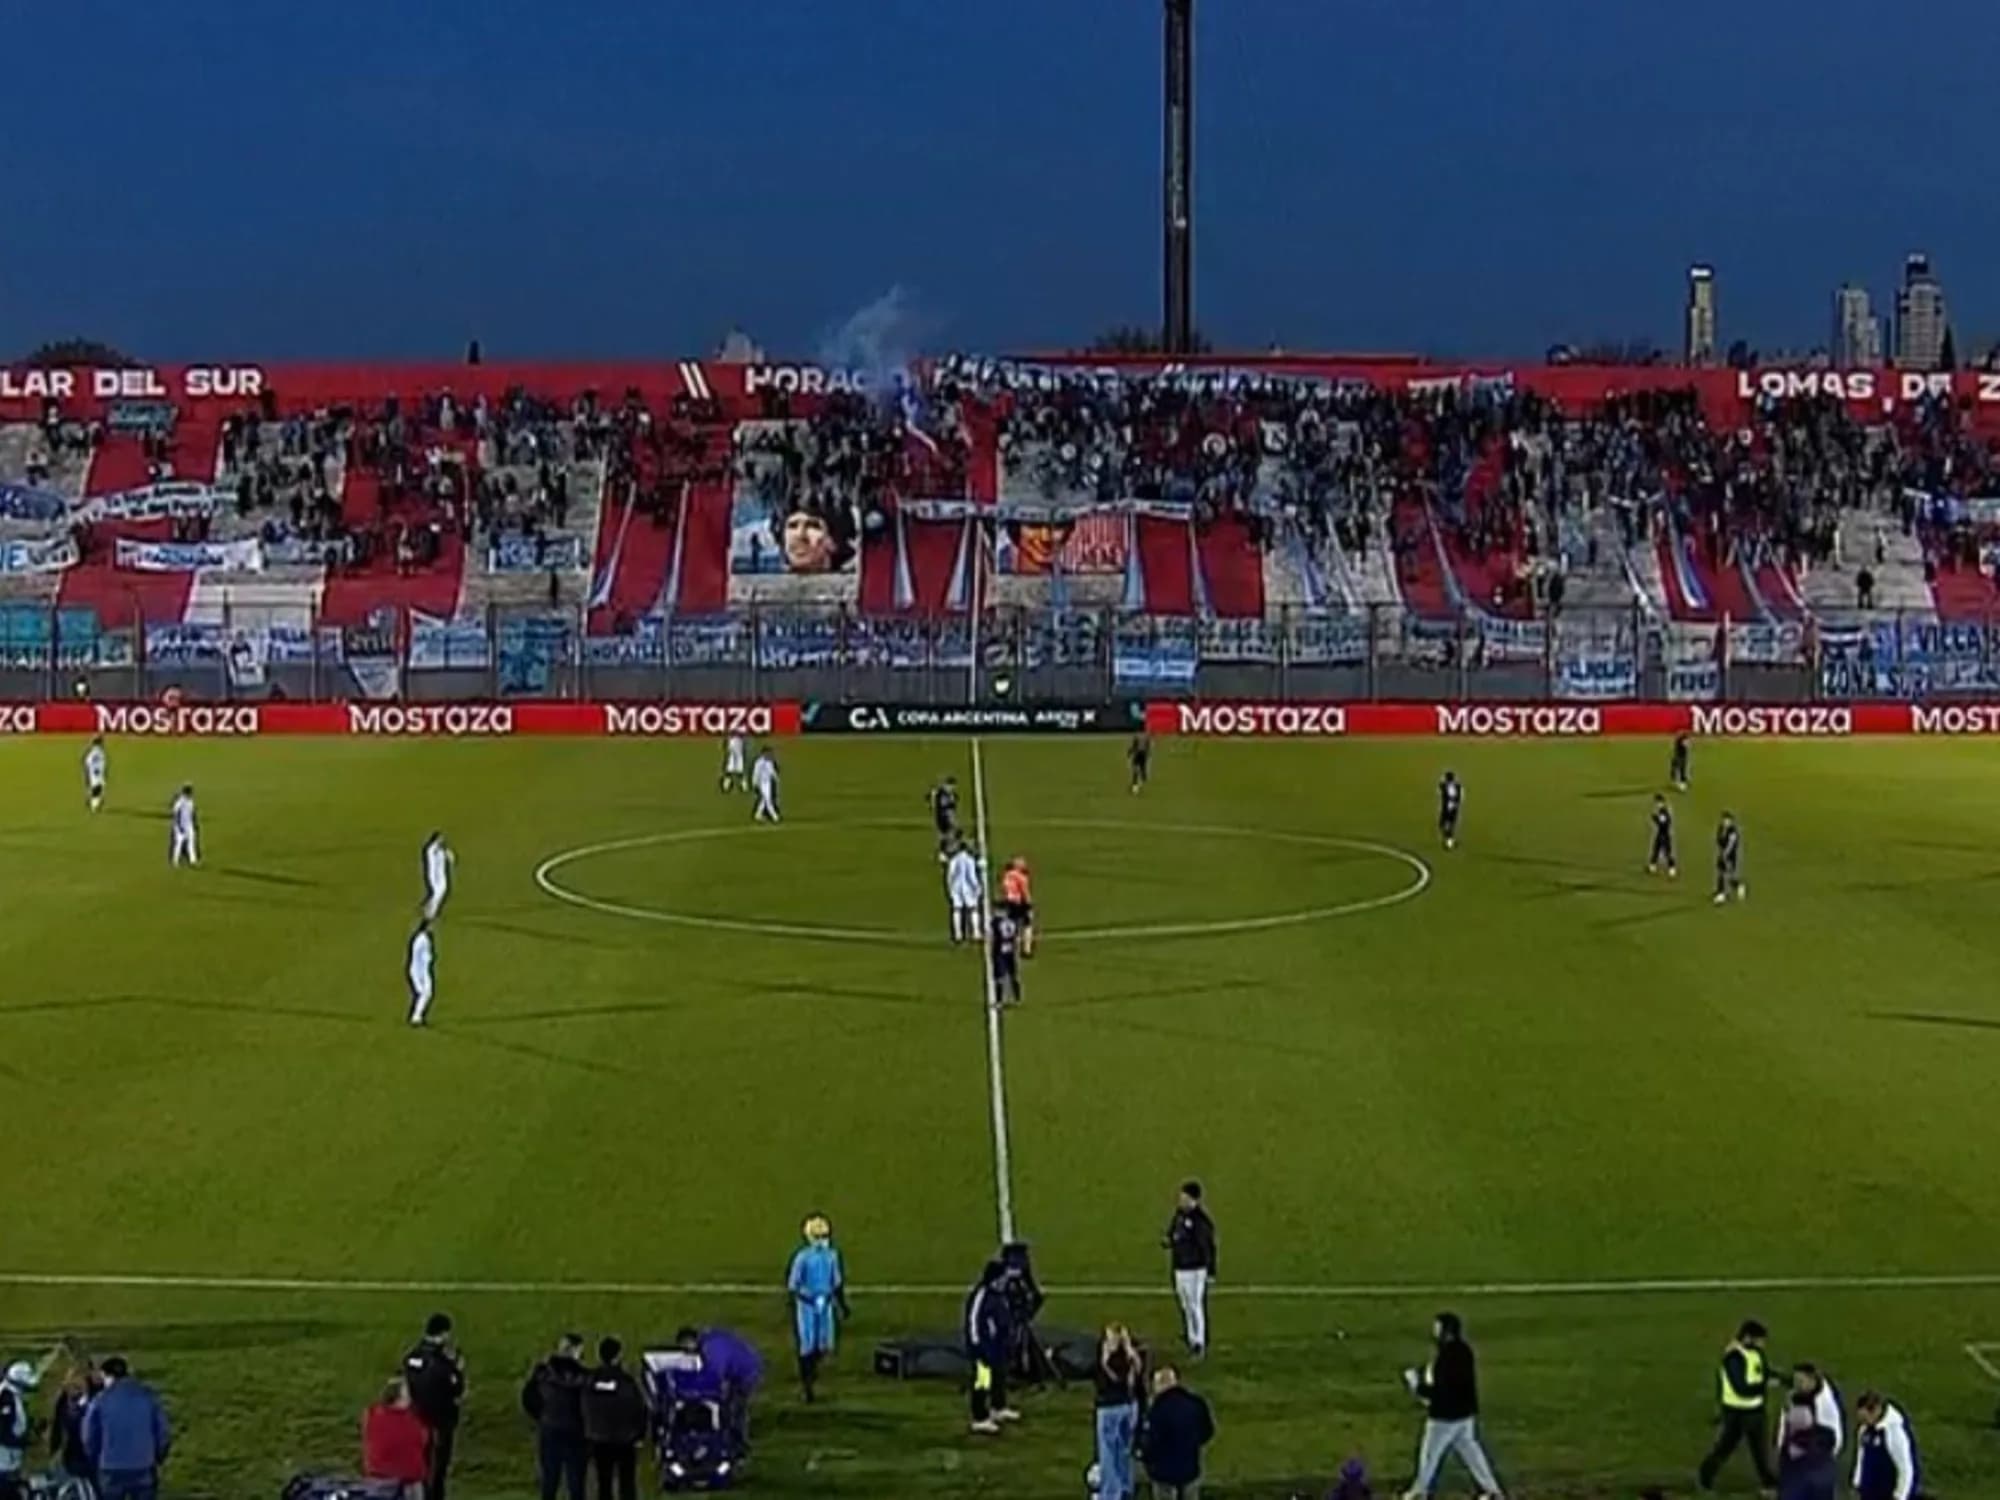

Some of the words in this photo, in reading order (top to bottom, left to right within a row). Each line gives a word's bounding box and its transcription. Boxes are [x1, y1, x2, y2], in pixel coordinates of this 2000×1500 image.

[1, 370, 73, 397] LAR
[94, 370, 165, 397] DEL
[185, 368, 262, 396] SUR
[1738, 371, 1874, 398] LOMAS
[897, 711, 939, 725] COPA
[943, 711, 1029, 725] ARGENTINA
